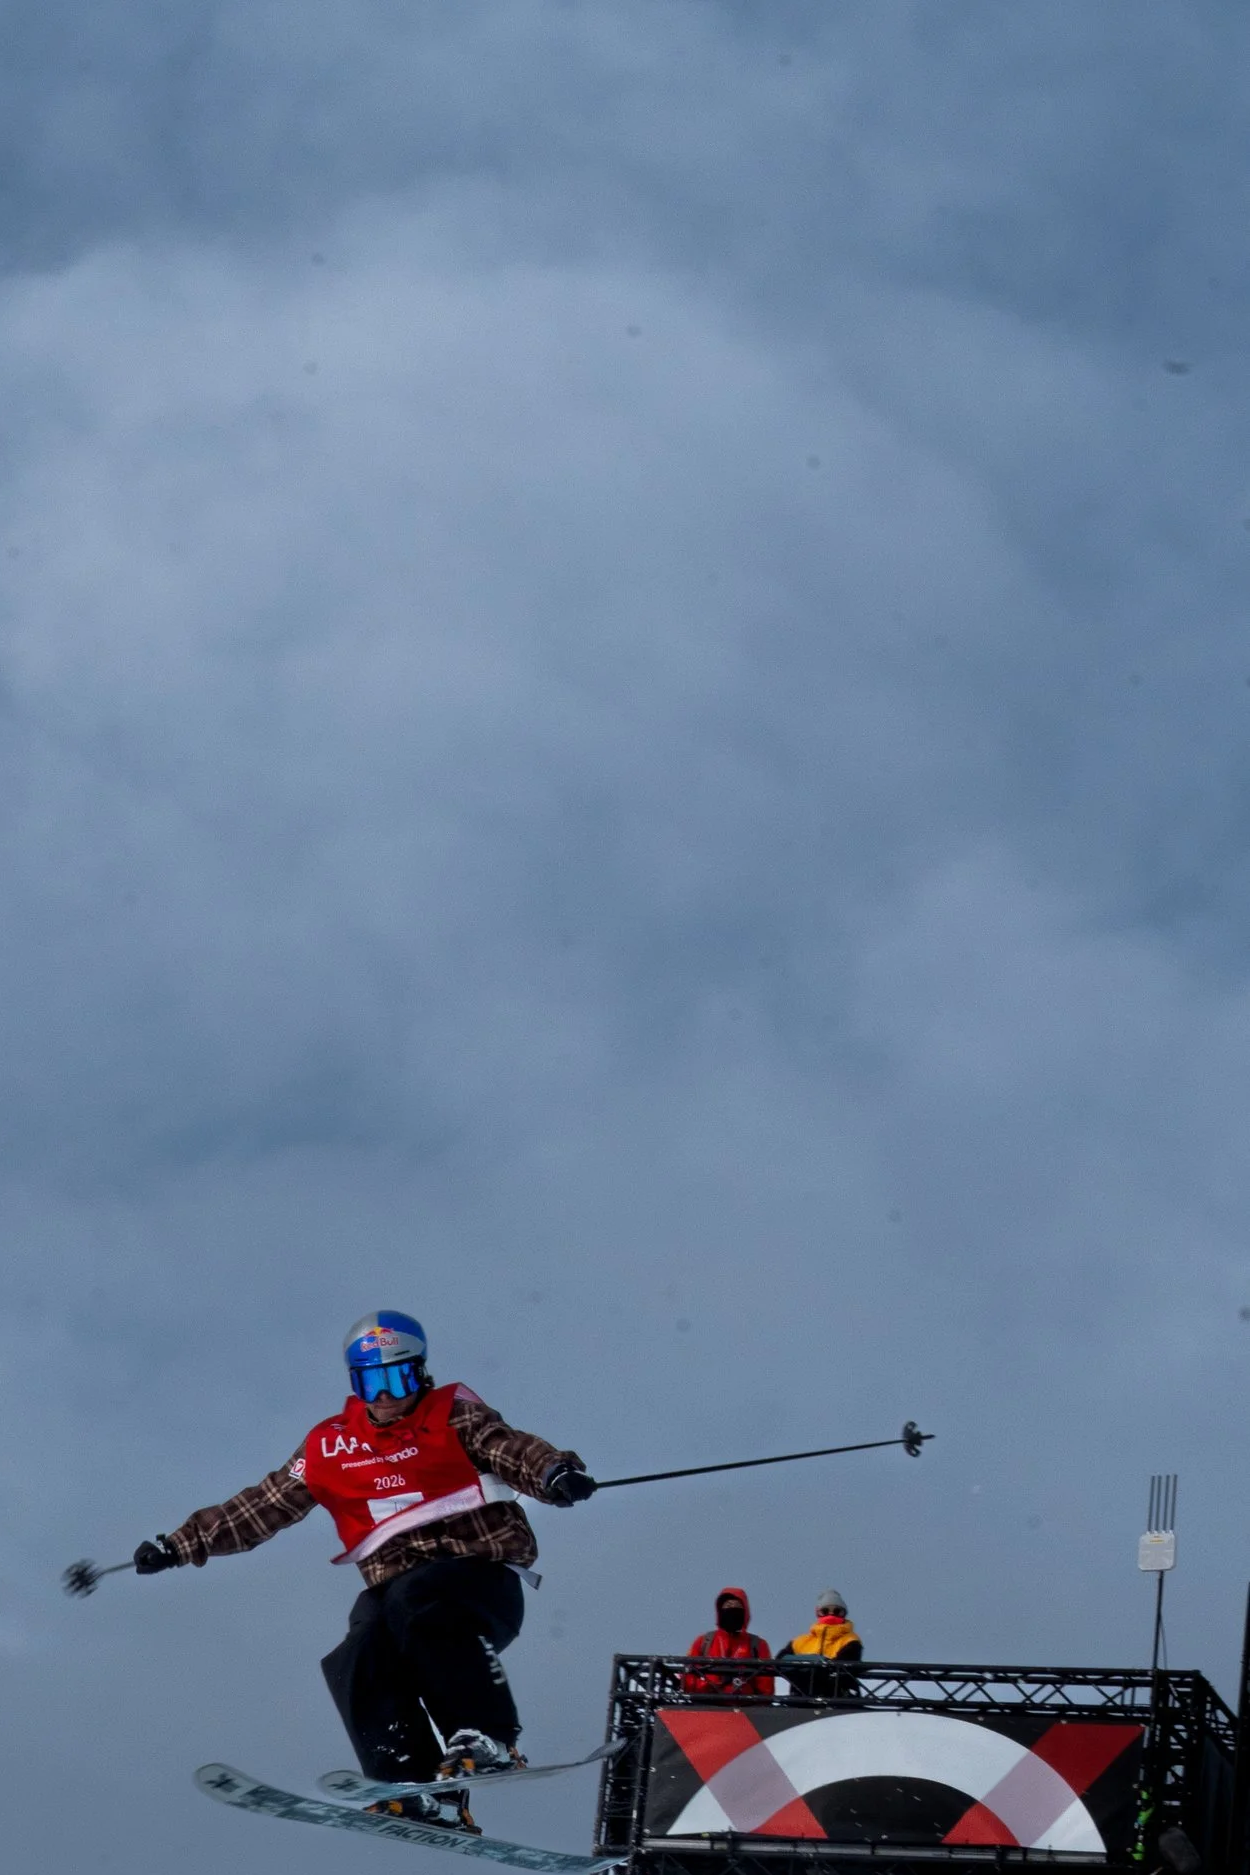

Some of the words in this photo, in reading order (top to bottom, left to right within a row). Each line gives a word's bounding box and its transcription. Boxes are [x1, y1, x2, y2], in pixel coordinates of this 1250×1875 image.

[361, 1341, 379, 1352] Red
[380, 1337, 399, 1347] Bull
[341, 1458, 377, 1471] presented
[373, 1474, 406, 1490] 2026
[378, 1824, 467, 1848] FACTION
